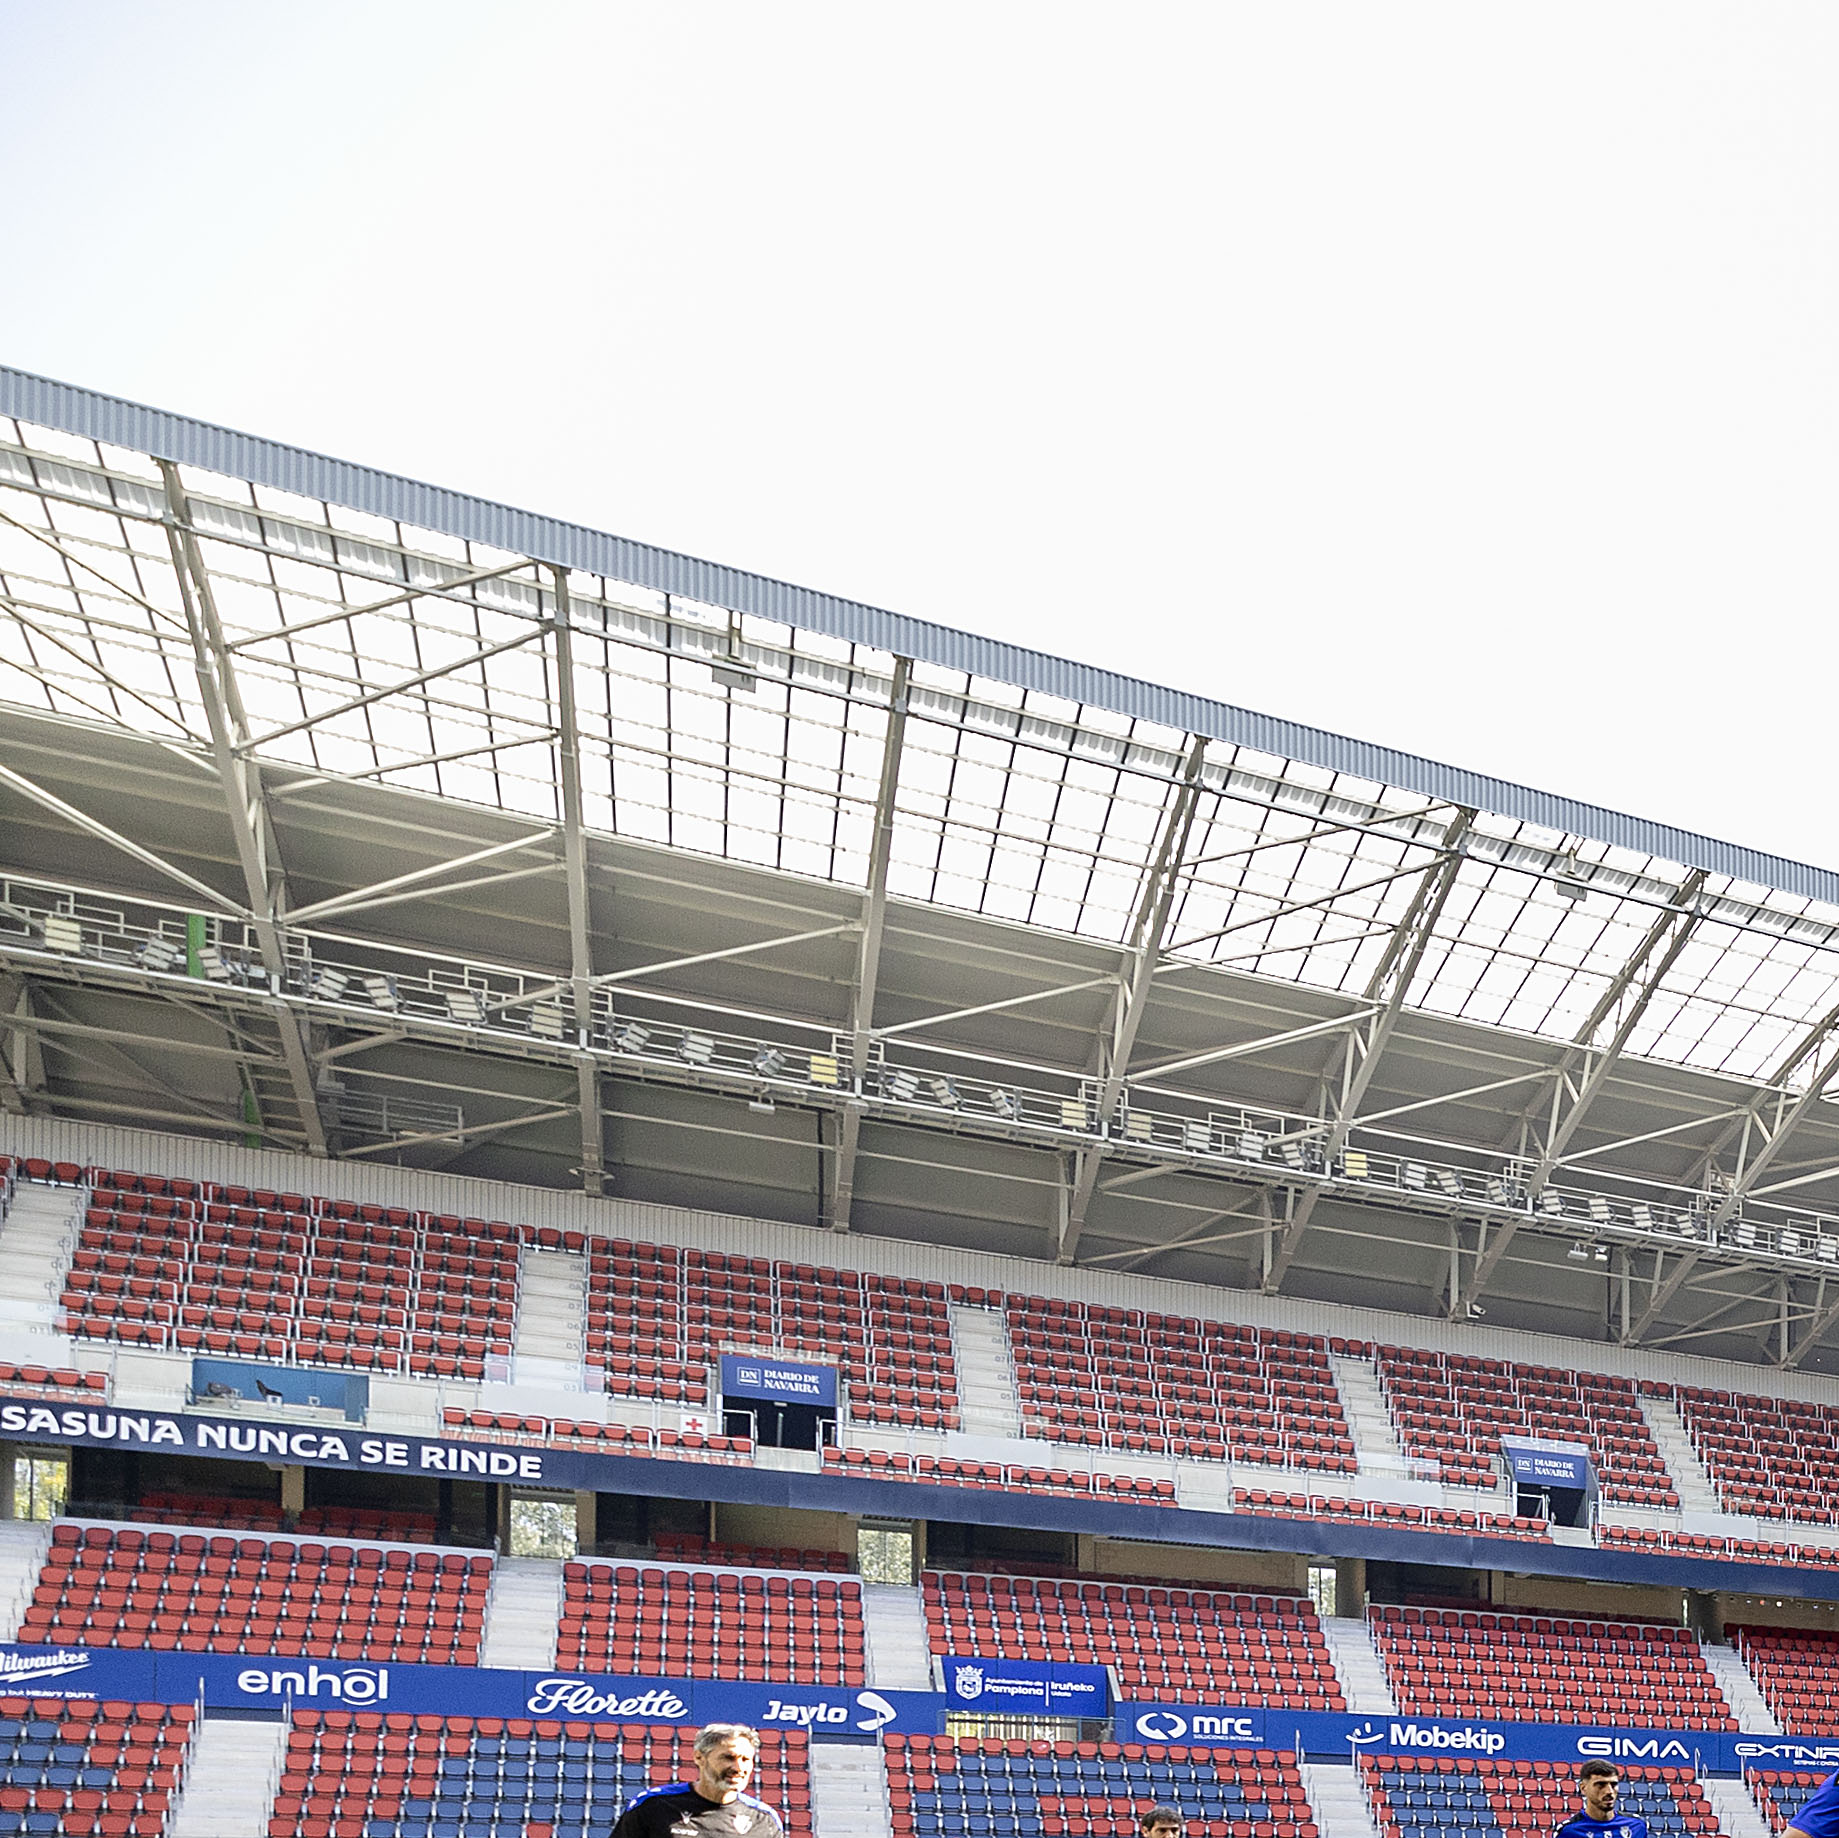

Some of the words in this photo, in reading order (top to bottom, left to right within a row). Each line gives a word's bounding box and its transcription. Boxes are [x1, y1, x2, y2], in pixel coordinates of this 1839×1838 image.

[740, 1369, 758, 1381] DN
[763, 1369, 802, 1382] DIARIO
[803, 1374, 820, 1384] DE
[763, 1379, 821, 1395] NAVARRA
[0, 1404, 184, 1446] SASUNA
[196, 1423, 350, 1461] NUNCA
[360, 1440, 409, 1466] SE
[420, 1445, 544, 1480] RINDE
[0, 1652, 90, 1673] ilwaukee
[237, 1665, 389, 1706] enhol
[984, 1683, 1044, 1697] Pamplona
[527, 1679, 688, 1718] Florette
[763, 1700, 848, 1726] Jaylo
[1193, 1715, 1252, 1736] mrc
[1390, 1724, 1505, 1751] Mobekip
[1576, 1736, 1690, 1760] GIMA
